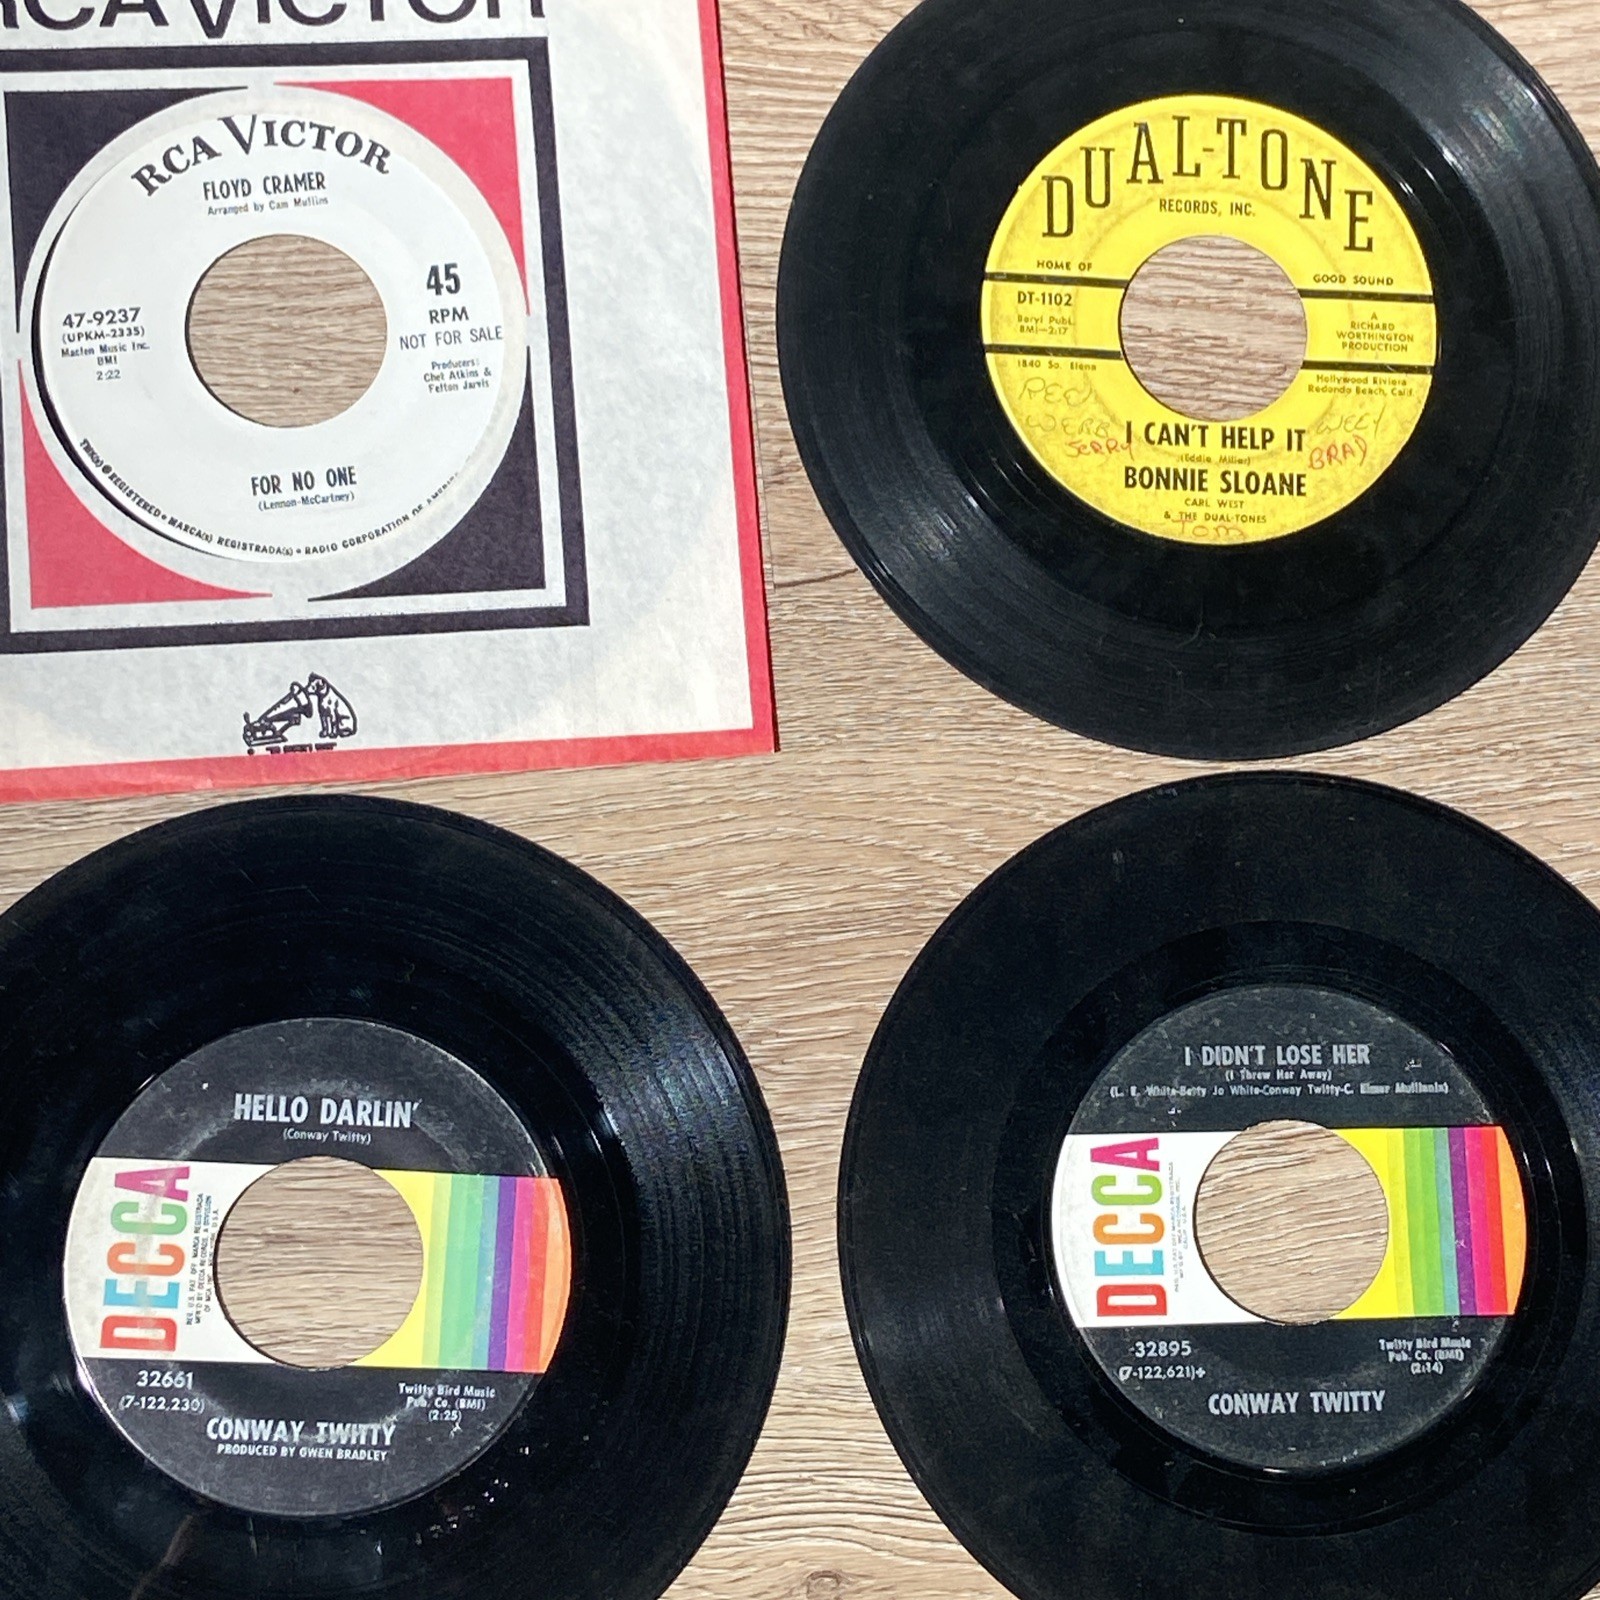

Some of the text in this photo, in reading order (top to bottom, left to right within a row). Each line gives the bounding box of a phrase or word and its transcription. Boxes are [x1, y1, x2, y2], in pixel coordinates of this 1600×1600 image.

[131, 114, 391, 197] RCA VICTOR
[203, 172, 326, 201] FLOYD CRAMER
[1041, 115, 1373, 252] DUAL-TONE
[208, 203, 249, 216] Arranged
[254, 202, 264, 213] by
[269, 200, 288, 210] Cam
[1159, 198, 1256, 217] RECORDS, INC.
[1037, 260, 1092, 271] HOME OF
[426, 263, 461, 296] 45
[1313, 274, 1394, 286] GOOD SOUND
[1018, 291, 1073, 306] DT-1102
[62, 307, 141, 329] 47-9237
[429, 306, 469, 325] RPM
[1370, 311, 1378, 320] A
[1350, 321, 1395, 331] RICHARD
[399, 325, 503, 350] NOT FOR SALE
[1336, 331, 1414, 342] WORTHINGTON
[100, 344, 127, 354] Music
[1342, 341, 1408, 352] PRODUCTION
[97, 355, 117, 366] BMI
[424, 367, 491, 383] Chet Atkins &
[1317, 374, 1368, 385] Hollywood
[428, 382, 458, 393] Felton
[1126, 421, 1306, 452] I CAN'T HELP IT
[251, 466, 357, 496] FOR NO ONE
[1124, 466, 1307, 496] BONNIE SLOANE
[1184, 498, 1245, 509] CARL WEST
[1164, 511, 1267, 524] & THE DUAL-TONES
[304, 542, 338, 555] RADIO
[342, 514, 410, 550] CORPORATION
[1185, 1044, 1370, 1066] I DIDN'T LOSE HER
[1240, 1069, 1270, 1080] Threw
[1276, 1069, 1294, 1080] Her
[1300, 1069, 1332, 1081] Away)
[1212, 1085, 1224, 1096] Jo
[1229, 1085, 1301, 1097] White-Conway
[234, 1093, 420, 1128] HELLO DARLIN'
[283, 1128, 371, 1145] (Conway Twitty)
[1090, 1137, 1167, 1317] DECCA
[99, 1166, 190, 1352] DECCA
[1135, 1340, 1192, 1358] 32895
[1379, 1338, 1413, 1351] Twitty
[1416, 1337, 1438, 1349] Bird
[1415, 1350, 1432, 1361] Co.
[136, 1370, 194, 1390] 32661
[398, 1383, 496, 1398] Twitty Bird Music
[118, 1395, 205, 1414] (7-122,230)
[434, 1397, 451, 1408] Co.
[455, 1398, 486, 1411] (BMI)
[1208, 1390, 1385, 1415] CONWAY TWITTY
[428, 1409, 462, 1422] (2:25)
[206, 1417, 396, 1446] CONWAY TWITTY
[216, 1444, 388, 1461] PRODUCED BY OWEN BRADLEY
